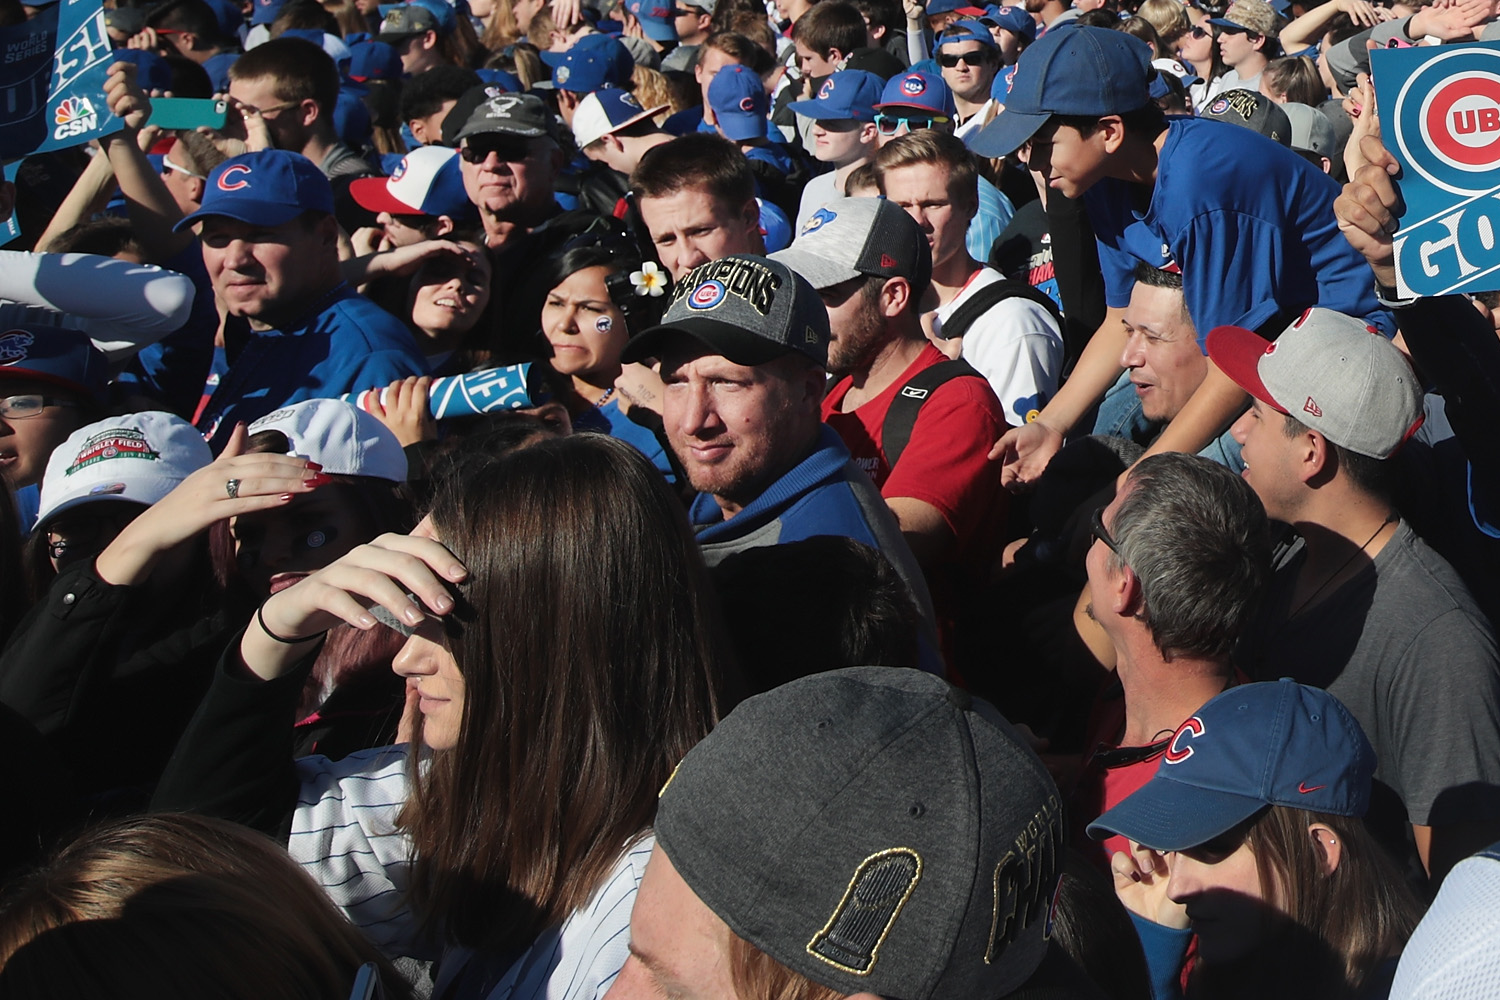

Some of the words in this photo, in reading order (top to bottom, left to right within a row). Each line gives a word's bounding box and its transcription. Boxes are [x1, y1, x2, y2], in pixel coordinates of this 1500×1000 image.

[54, 113, 97, 140] CSN
[218, 164, 251, 190] C
[80, 439, 116, 458] WRIGLEY
[118, 439, 142, 449] FIELD
[1164, 716, 1205, 766] C
[1015, 794, 1059, 853] WORLD
